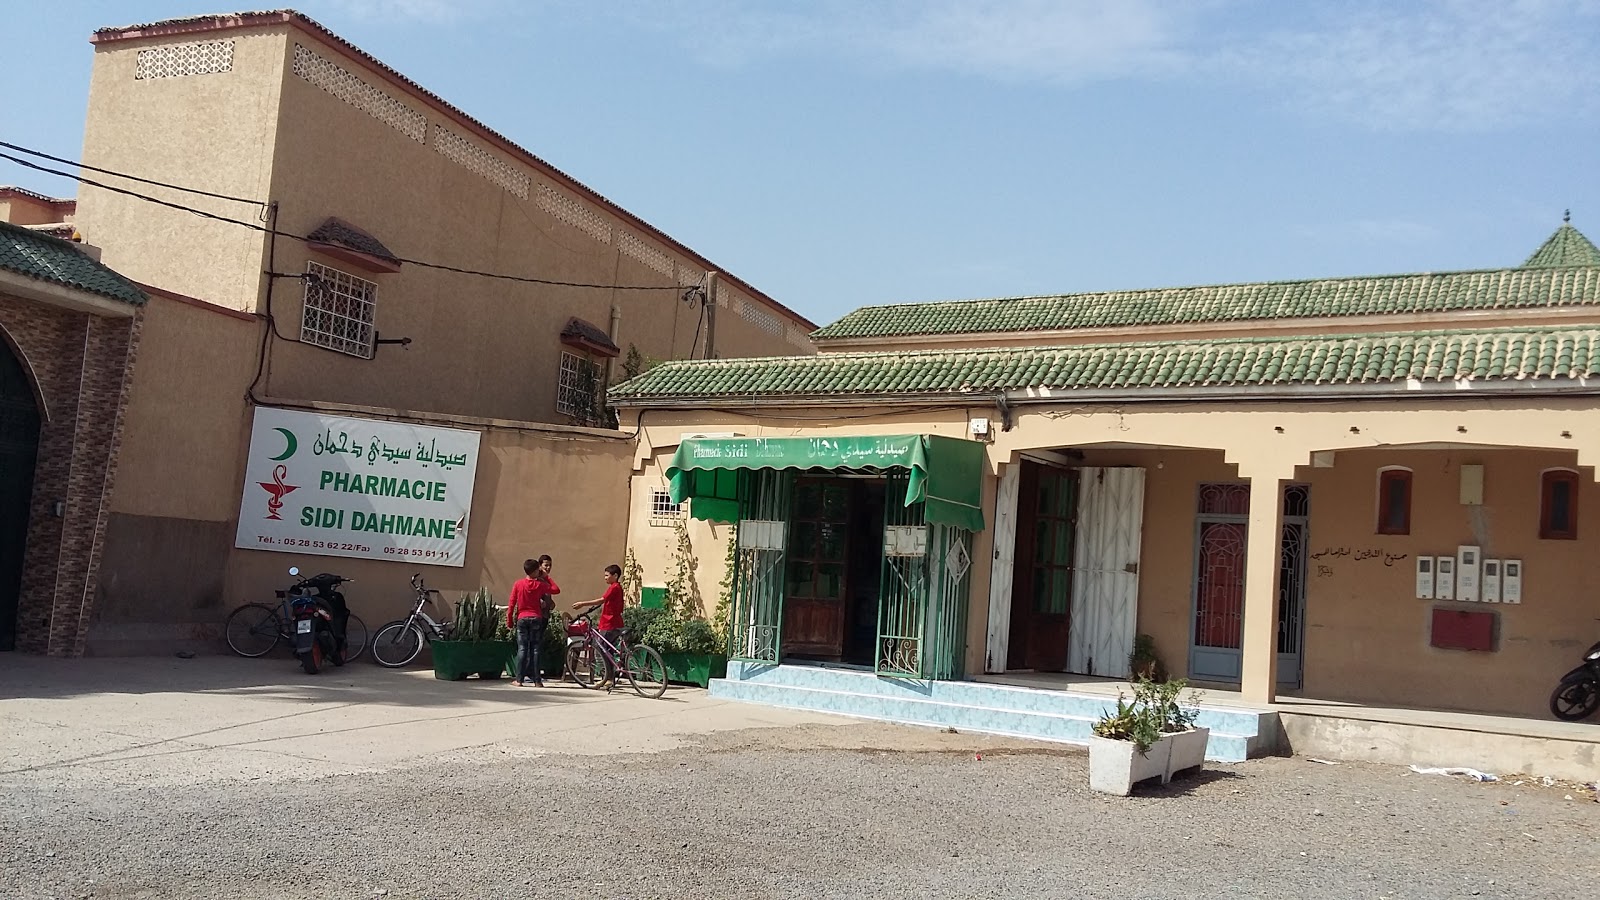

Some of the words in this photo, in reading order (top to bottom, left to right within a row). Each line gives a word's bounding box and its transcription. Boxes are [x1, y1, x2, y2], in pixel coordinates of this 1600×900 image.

[313, 427, 363, 458] دحمان
[367, 435, 411, 466] سيدي
[416, 437, 467, 470] صيدلية
[724, 443, 748, 458] Sidi
[319, 470, 447, 502] PHARMACIE
[300, 506, 344, 529] SIDI
[350, 511, 457, 540] DAHMANE
[284, 538, 296, 546] 05
[298, 539, 310, 547] 28
[312, 540, 324, 548] 53
[384, 546, 395, 554] 05
[397, 547, 409, 555] 28
[411, 549, 423, 557] 53
[439, 551, 450, 559] 11
